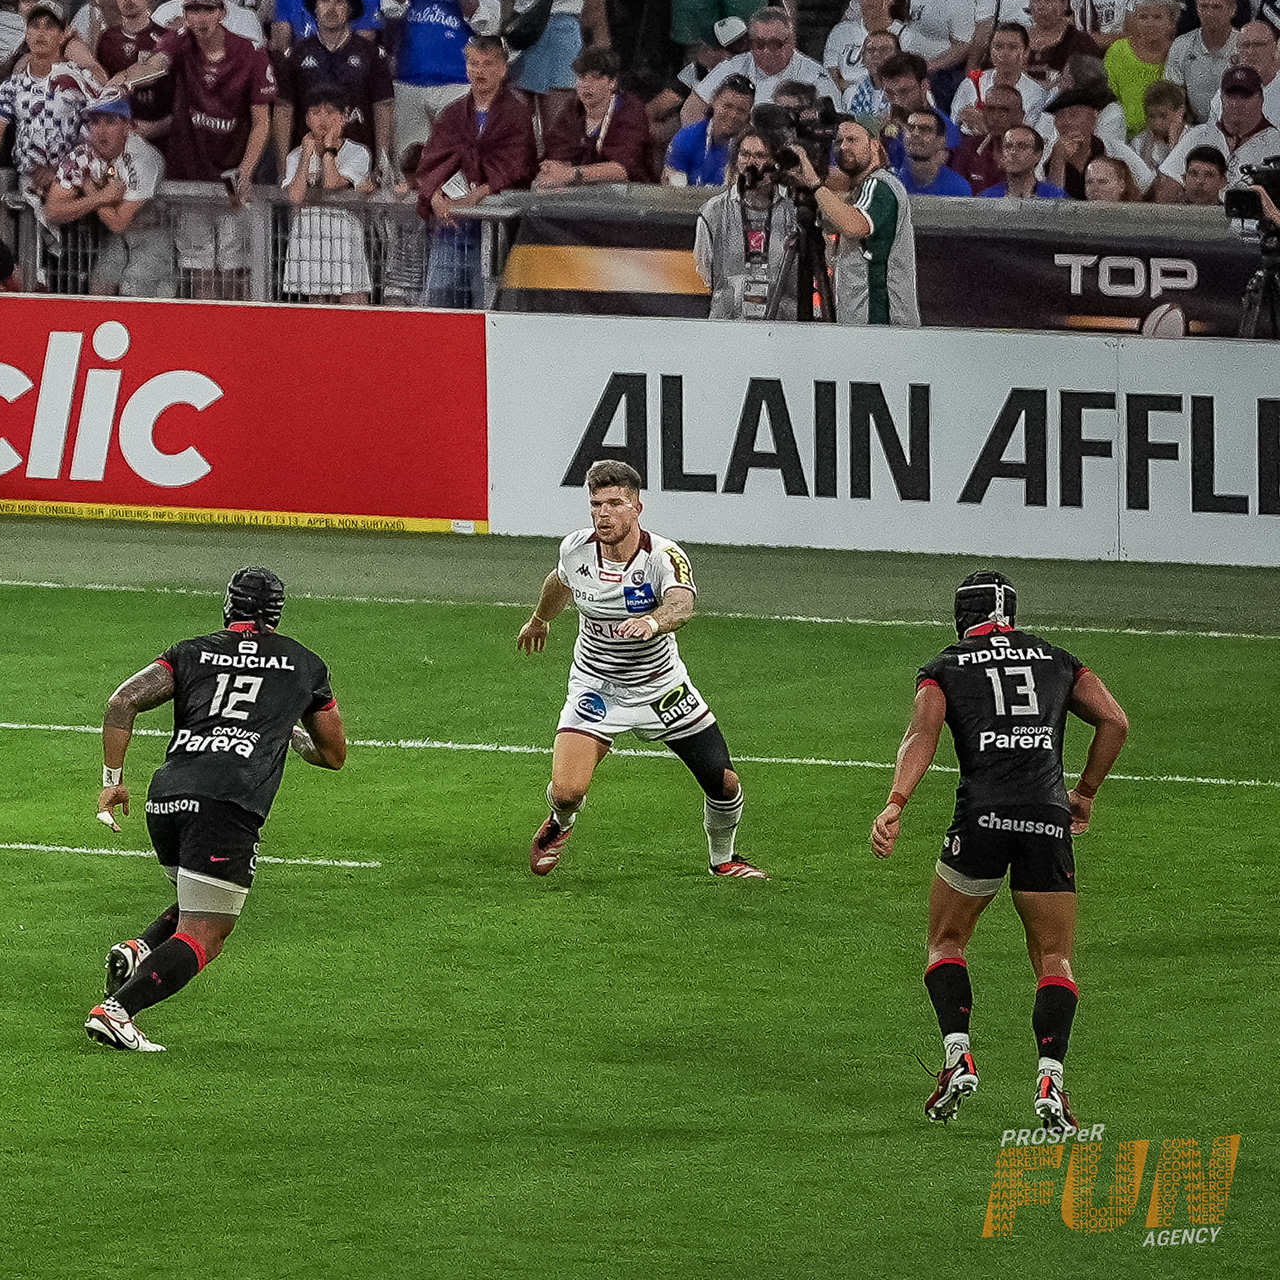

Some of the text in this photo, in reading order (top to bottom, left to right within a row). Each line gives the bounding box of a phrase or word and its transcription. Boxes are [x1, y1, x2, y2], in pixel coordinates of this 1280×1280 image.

[1054, 252, 1199, 300] TOP
[560, 371, 931, 502] ALAIN
[575, 588, 594, 602] psa
[199, 650, 295, 671] FIDUCIAL
[957, 647, 1053, 666] FIDUCIAL
[208, 673, 264, 721] 12
[984, 665, 1040, 716] 13
[661, 693, 697, 723] ange
[169, 728, 255, 758] Parera
[211, 725, 261, 743] GROUPE
[979, 730, 1053, 752] Parera
[1012, 725, 1054, 736] GROUPE
[978, 812, 1064, 840] chausson
